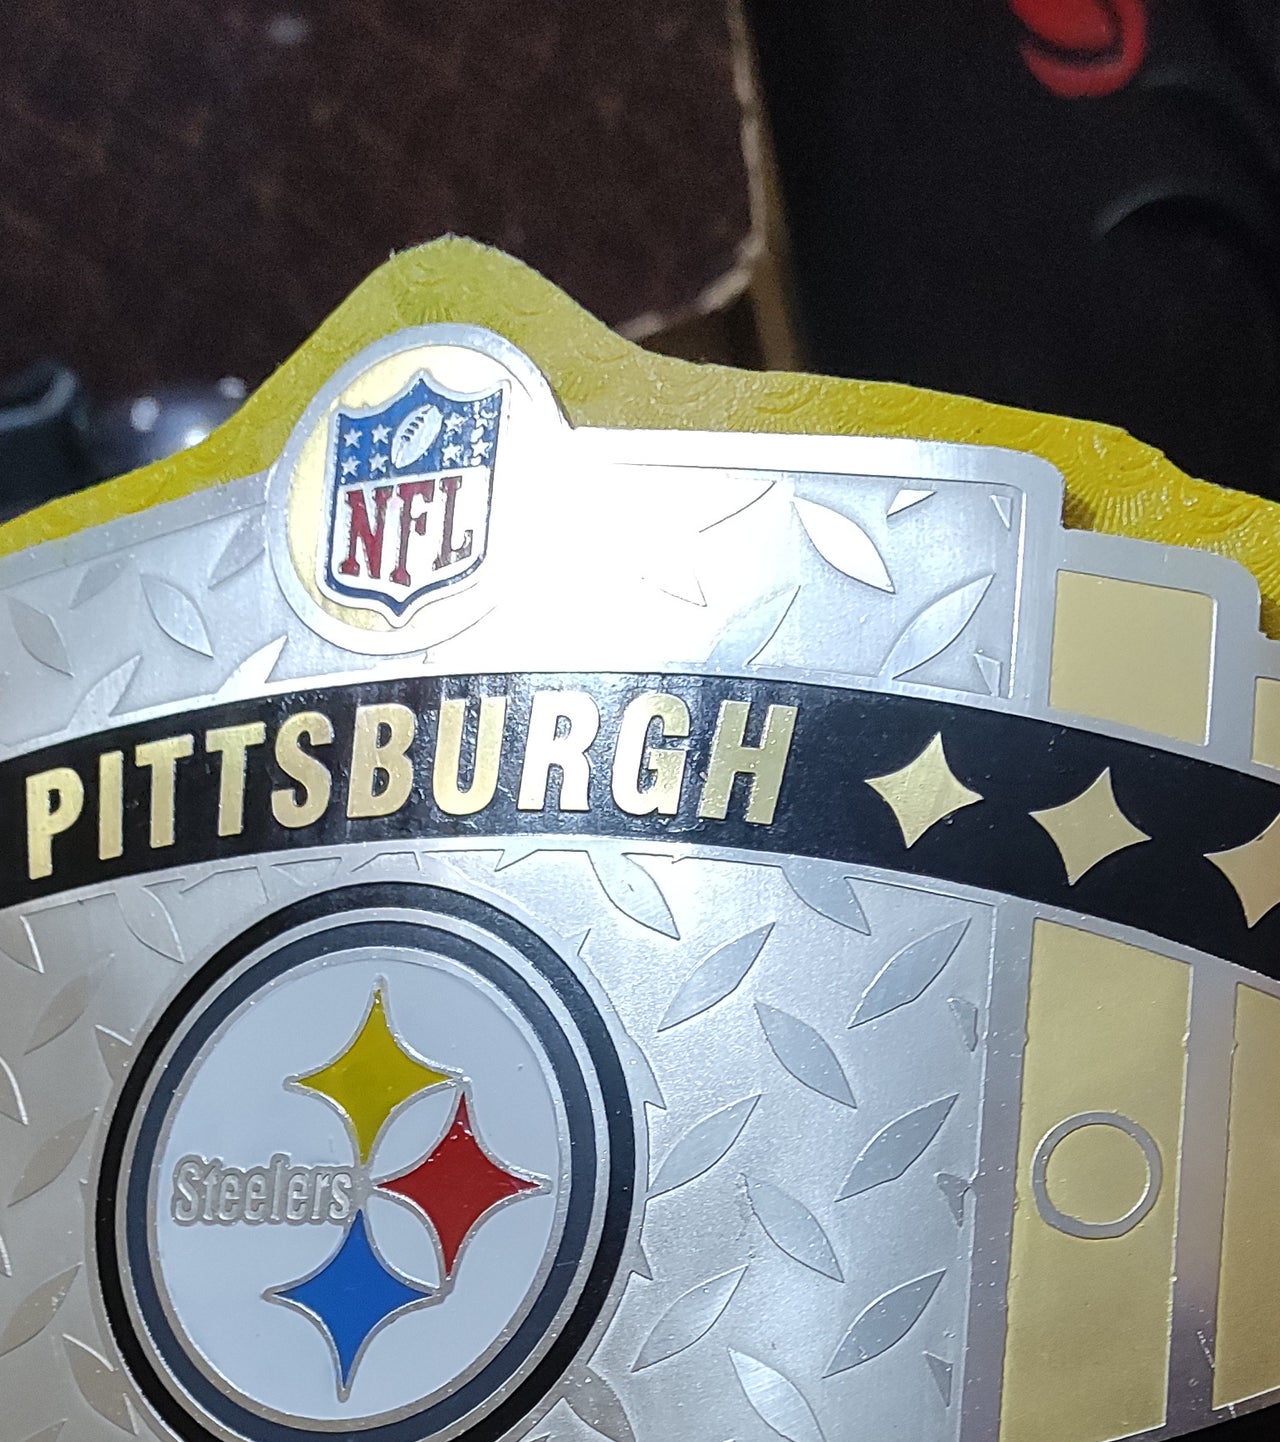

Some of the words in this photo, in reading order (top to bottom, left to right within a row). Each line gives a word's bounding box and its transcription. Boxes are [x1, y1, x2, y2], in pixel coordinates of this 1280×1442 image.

[339, 474, 475, 588] NFL
[24, 690, 798, 882] PITTSBURGH
[173, 1155, 354, 1225] Steelers
